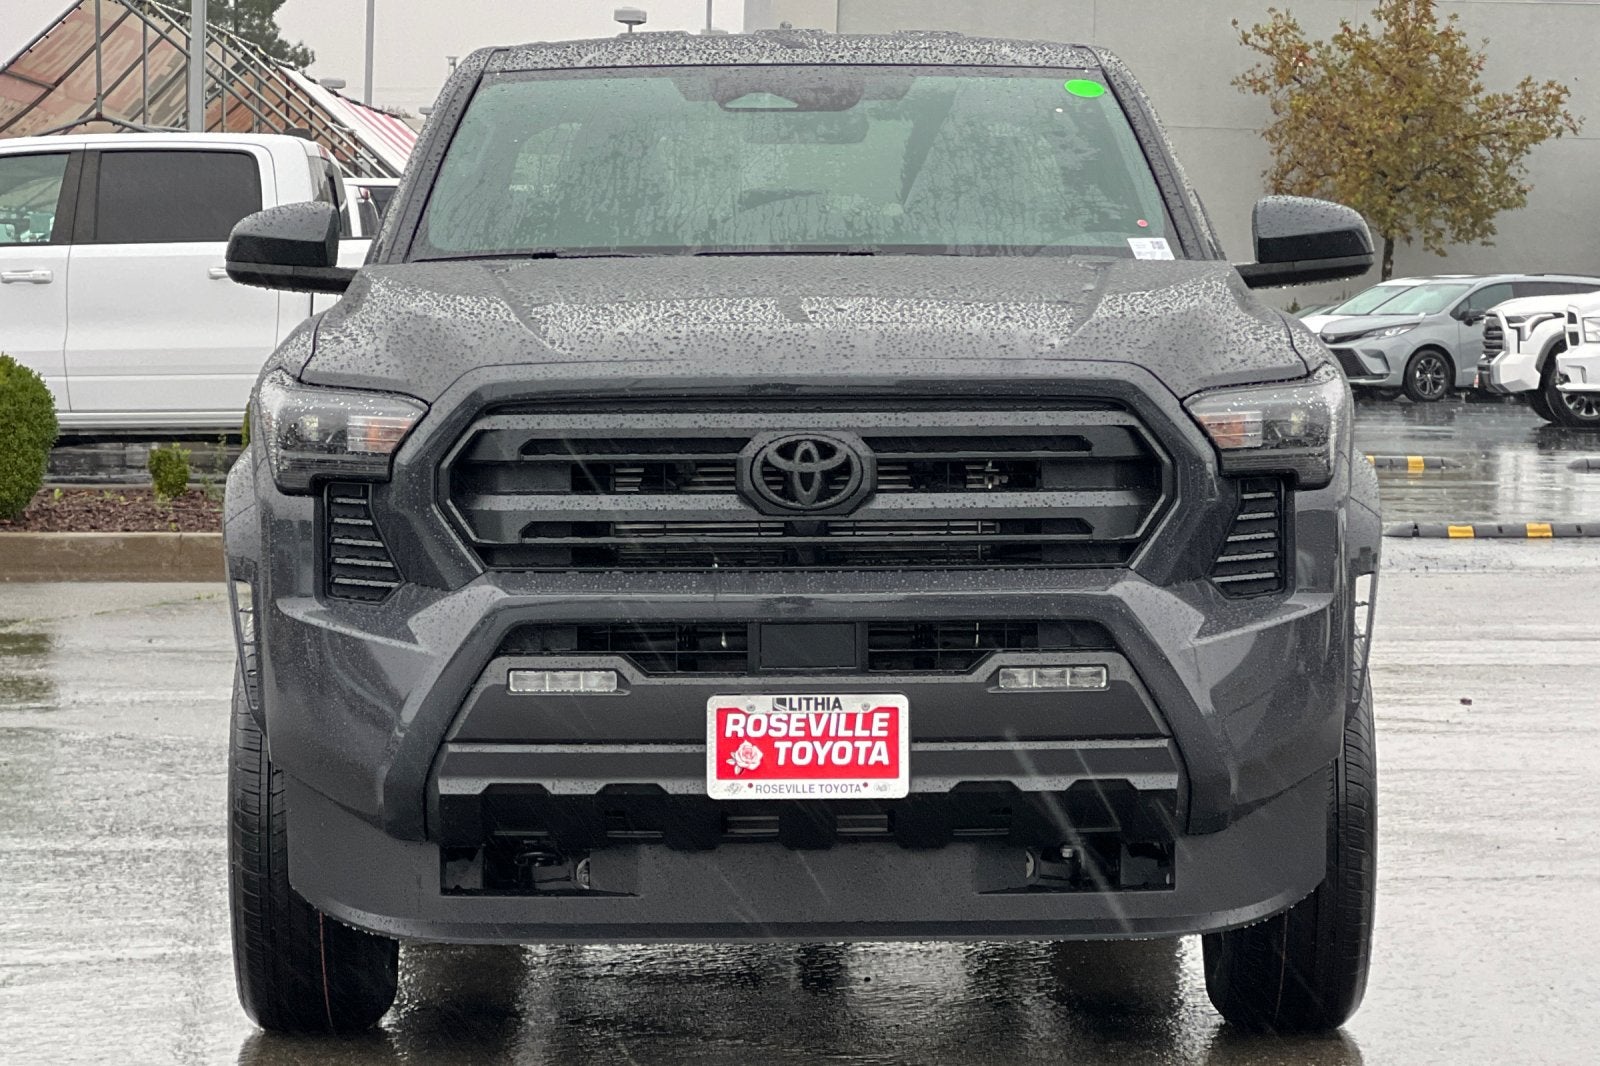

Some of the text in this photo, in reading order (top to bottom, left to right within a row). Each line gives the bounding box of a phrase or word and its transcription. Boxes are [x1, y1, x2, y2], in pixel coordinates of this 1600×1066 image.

[788, 697, 843, 711] LITHIA
[725, 713, 890, 738] ROSEVILLE
[774, 741, 890, 765] TOYOTA
[755, 783, 862, 794] ROSEVILLE TOYOTA
